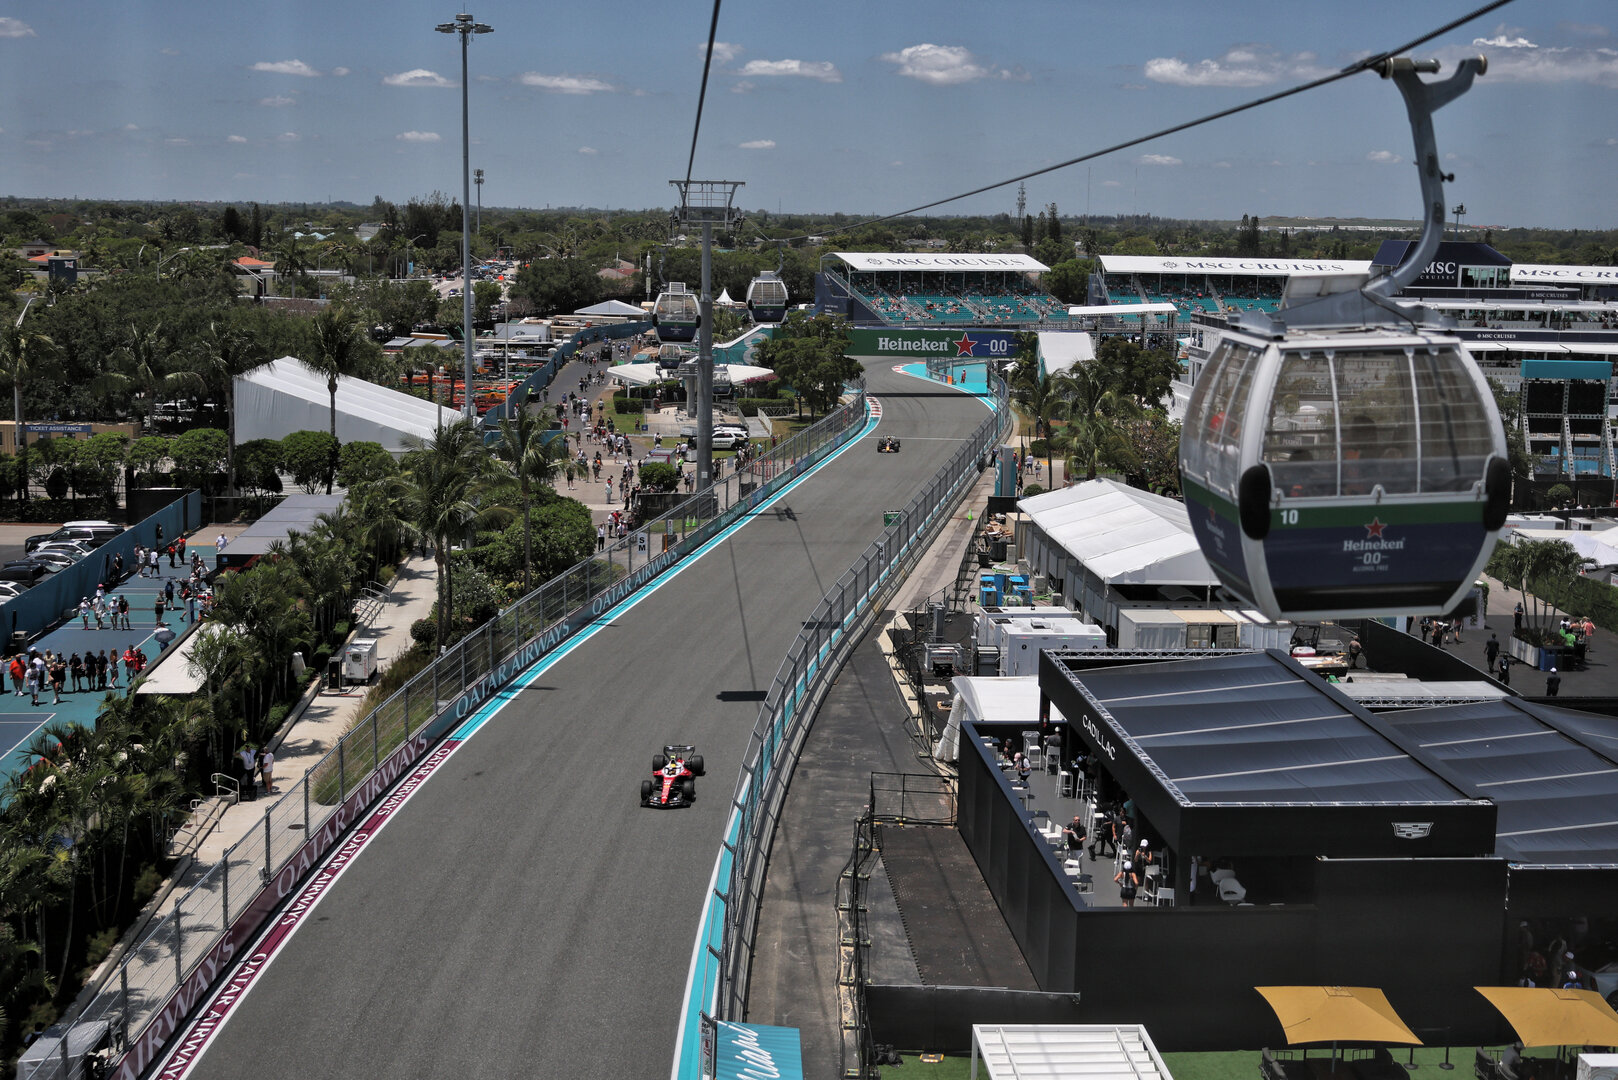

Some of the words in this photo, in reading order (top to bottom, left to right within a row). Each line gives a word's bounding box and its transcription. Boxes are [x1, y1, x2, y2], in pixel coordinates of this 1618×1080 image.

[886, 258, 931, 266] MSC
[934, 258, 1025, 266] CRUISES
[1239, 262, 1345, 271] CRUISES
[1518, 269, 1569, 277] MSC
[877, 337, 949, 352] Heineken
[1280, 509, 1299, 525] 10
[1343, 538, 1404, 551] Heineken
[592, 580, 632, 615] QATAR
[634, 549, 678, 588] AIRWAYS
[456, 663, 508, 719] QATAR
[511, 618, 570, 674] AIRWAYS
[1083, 714, 1116, 761] CADILLAC
[415, 748, 450, 777] QATAR
[277, 808, 348, 899] QATAR
[352, 731, 428, 816] AIRWAYS
[377, 777, 420, 815] AIRWAYS
[326, 833, 368, 871] QATAR
[281, 872, 332, 925] AIRWAYS
[216, 953, 267, 1007] QATAR
[157, 1009, 222, 1080] AIRWAY
